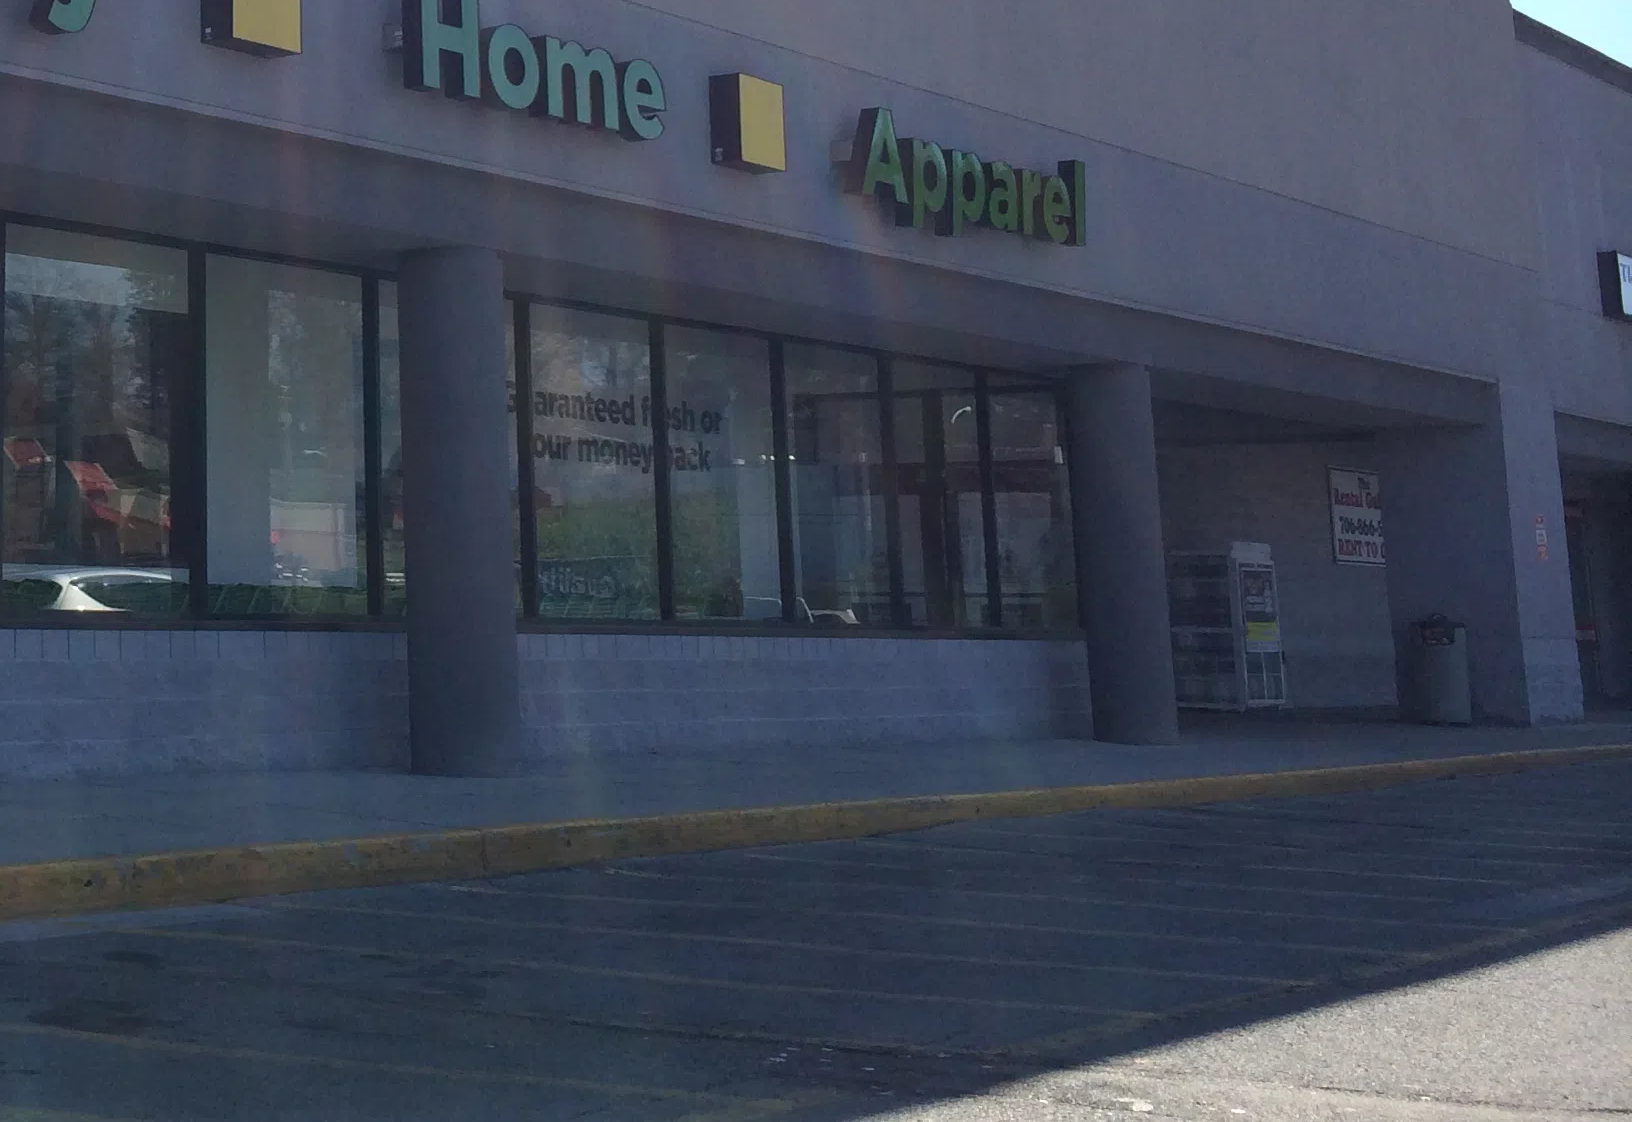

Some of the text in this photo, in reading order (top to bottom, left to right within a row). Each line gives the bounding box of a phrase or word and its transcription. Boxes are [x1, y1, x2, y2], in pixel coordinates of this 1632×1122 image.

[863, 107, 1086, 246] Apparel
[506, 380, 722, 434] aranteed fsh or
[533, 432, 712, 475] our money ack
